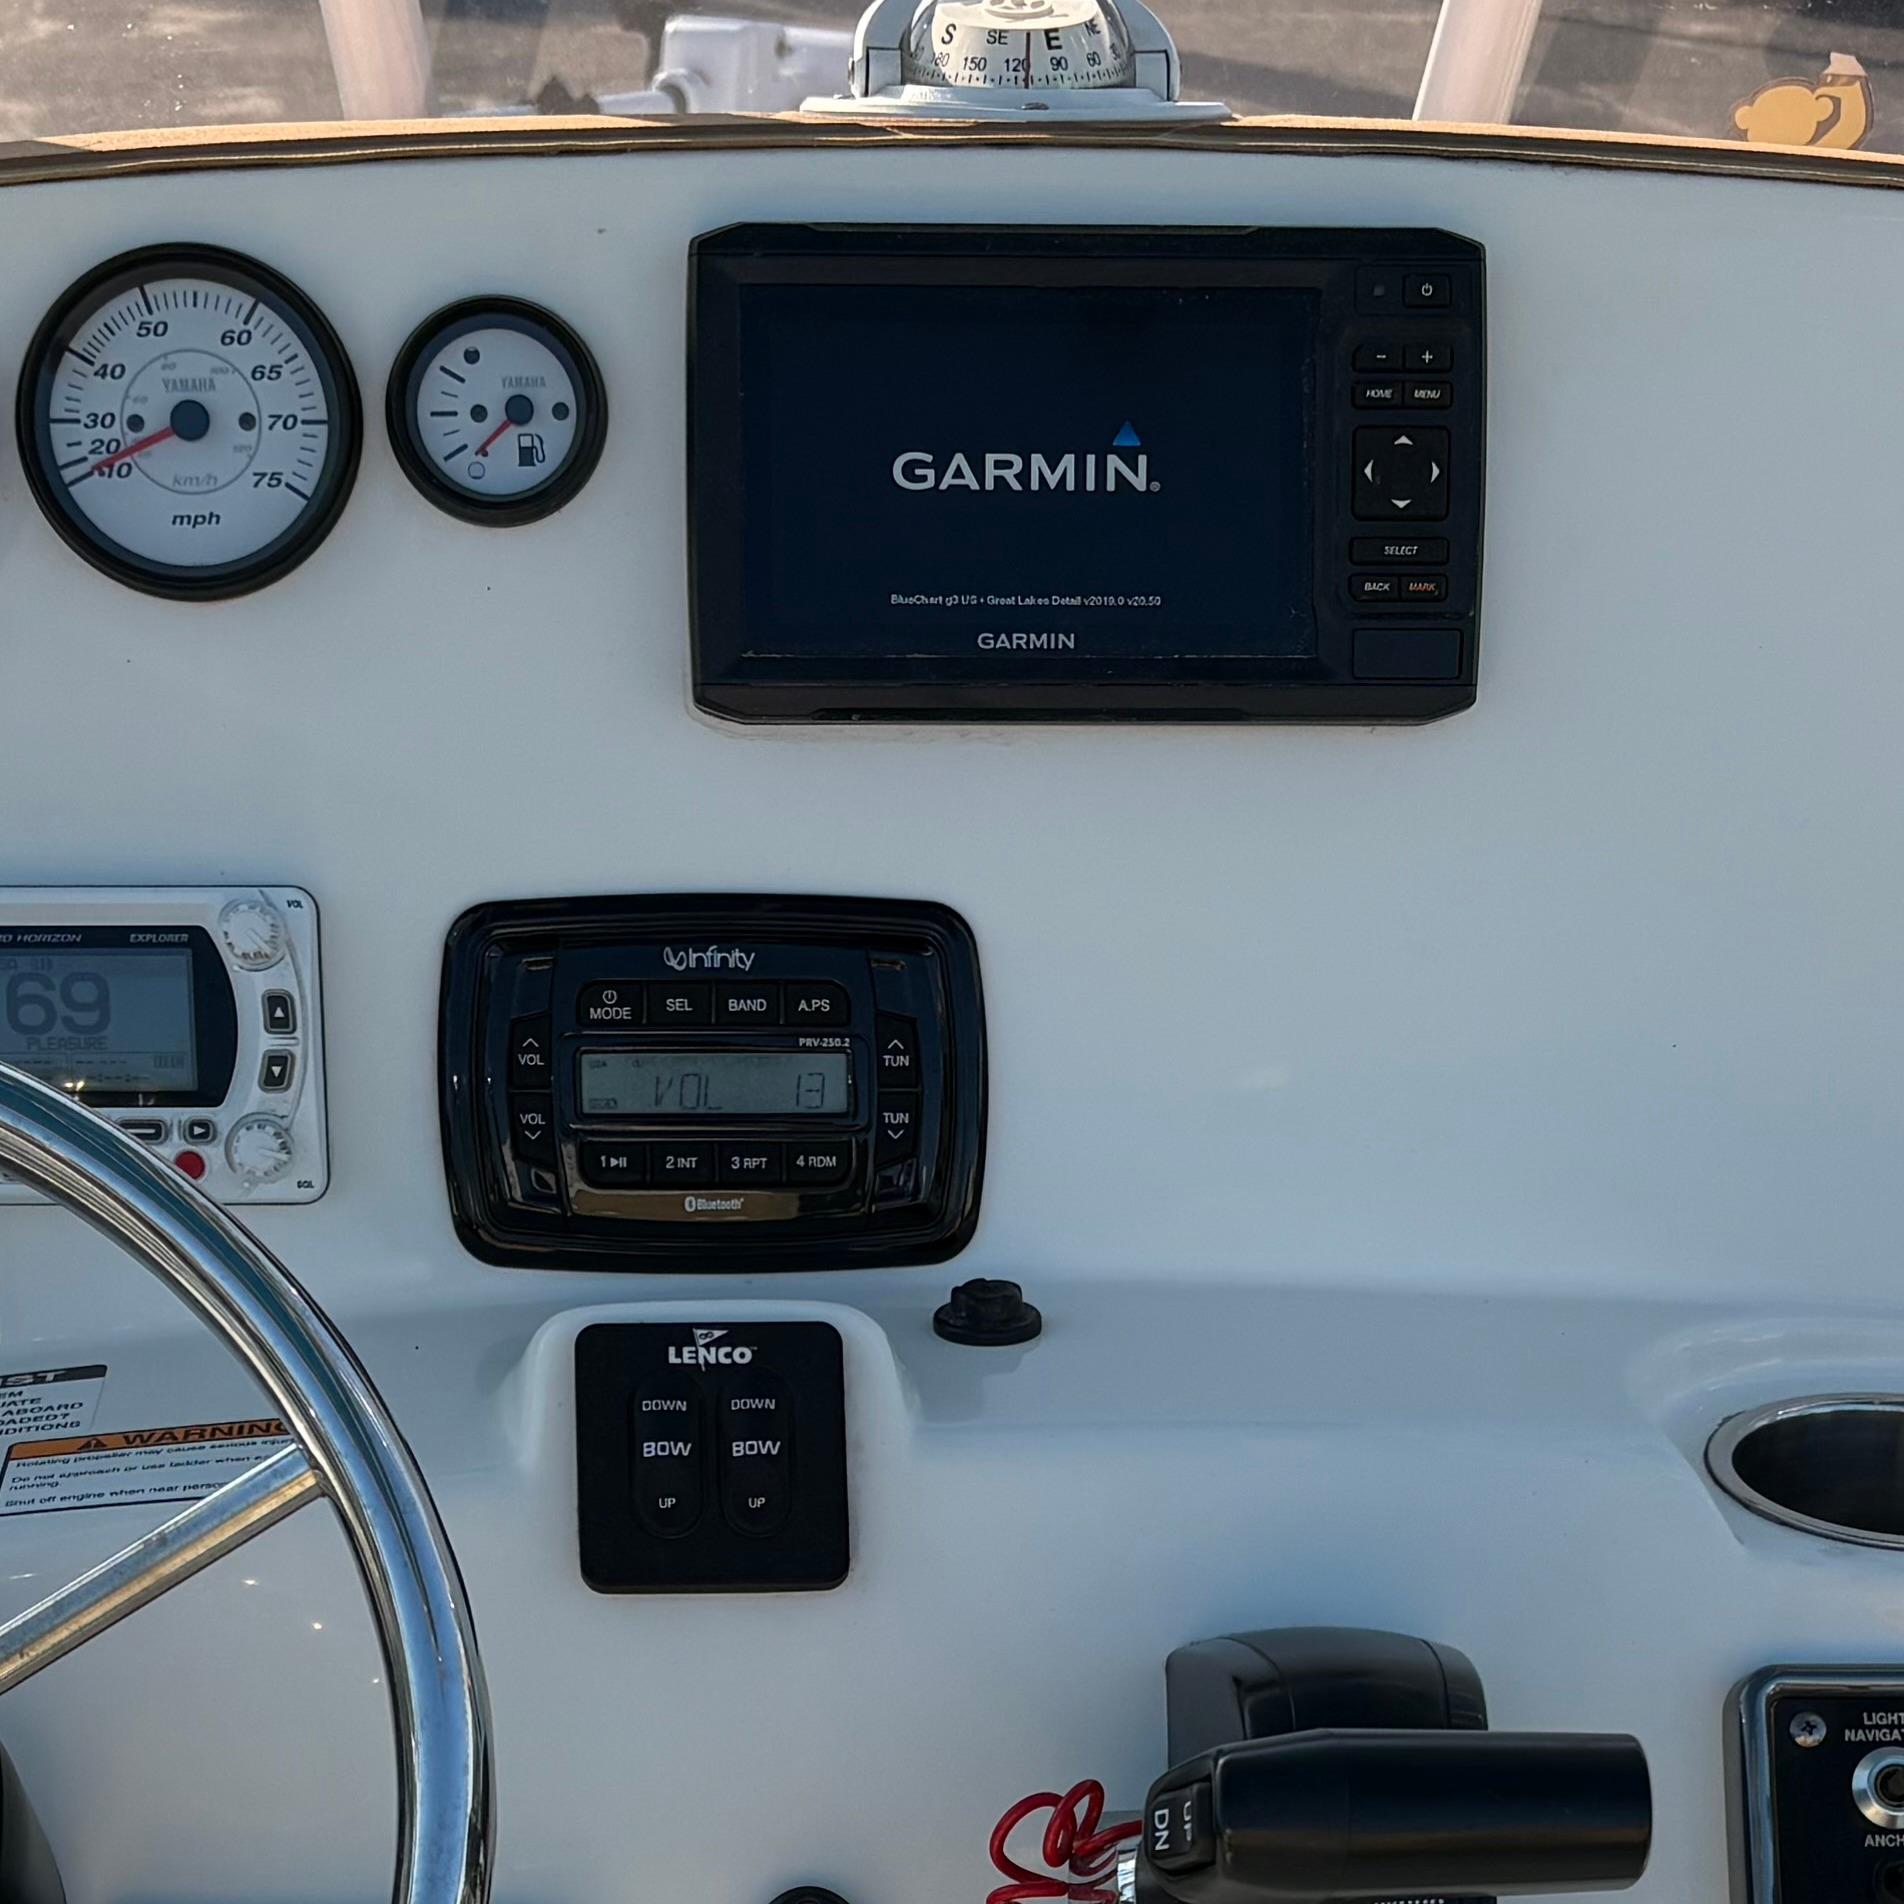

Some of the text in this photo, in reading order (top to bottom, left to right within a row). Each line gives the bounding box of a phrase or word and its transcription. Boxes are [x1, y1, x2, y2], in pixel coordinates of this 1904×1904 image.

[942, 24, 956, 45] S
[986, 30, 1008, 45] SE
[1044, 28, 1062, 50] E
[964, 57, 987, 71] 150
[1050, 56, 1068, 71] 90
[1086, 51, 1101, 67] 60
[136, 321, 169, 337] 50
[220, 330, 252, 347] 60
[94, 363, 126, 380] 40
[251, 364, 283, 381] 65
[162, 377, 216, 393] YAMAHA
[1366, 389, 1393, 399] HOME
[1414, 389, 1441, 399] MENU
[83, 412, 116, 429] 30
[267, 414, 298, 430] 70
[88, 438, 121, 455] 20
[172, 474, 218, 488] km/h
[252, 472, 283, 488] 75
[172, 512, 221, 528] mph
[1384, 546, 1418, 555] SELECT
[1364, 582, 1390, 591] BACK
[1408, 582, 1437, 592] MARK
[977, 633, 1075, 649] GARMIN
[286, 900, 304, 909] VOL
[16, 933, 82, 943] HORIZON
[130, 933, 189, 944] EXPLORER
[5, 971, 111, 1035] 69
[666, 999, 693, 1012] SEL
[728, 998, 767, 1012] BAND
[590, 1007, 632, 1021] MODE
[26, 1036, 108, 1051] PLEASURE
[518, 1054, 544, 1066] VOL
[884, 1054, 909, 1067] TUN
[654, 1073, 722, 1110] VOL
[520, 1112, 545, 1125] VOL
[883, 1112, 909, 1125] TUN
[600, 1156, 606, 1168] 1
[666, 1156, 698, 1169] 2 INT
[731, 1156, 768, 1169] 3 RPT
[796, 1156, 837, 1168] 4 RDM
[668, 1346, 753, 1365] LENCO
[2, 1402, 84, 1416] ABOARD
[642, 1400, 687, 1412] DOWN
[731, 1398, 776, 1410] DOWN
[643, 1442, 692, 1457] BOW
[732, 1440, 781, 1457] BOW
[659, 1498, 676, 1509] UP
[748, 1497, 766, 1509] UP
[1154, 1808, 1170, 1851] DN
